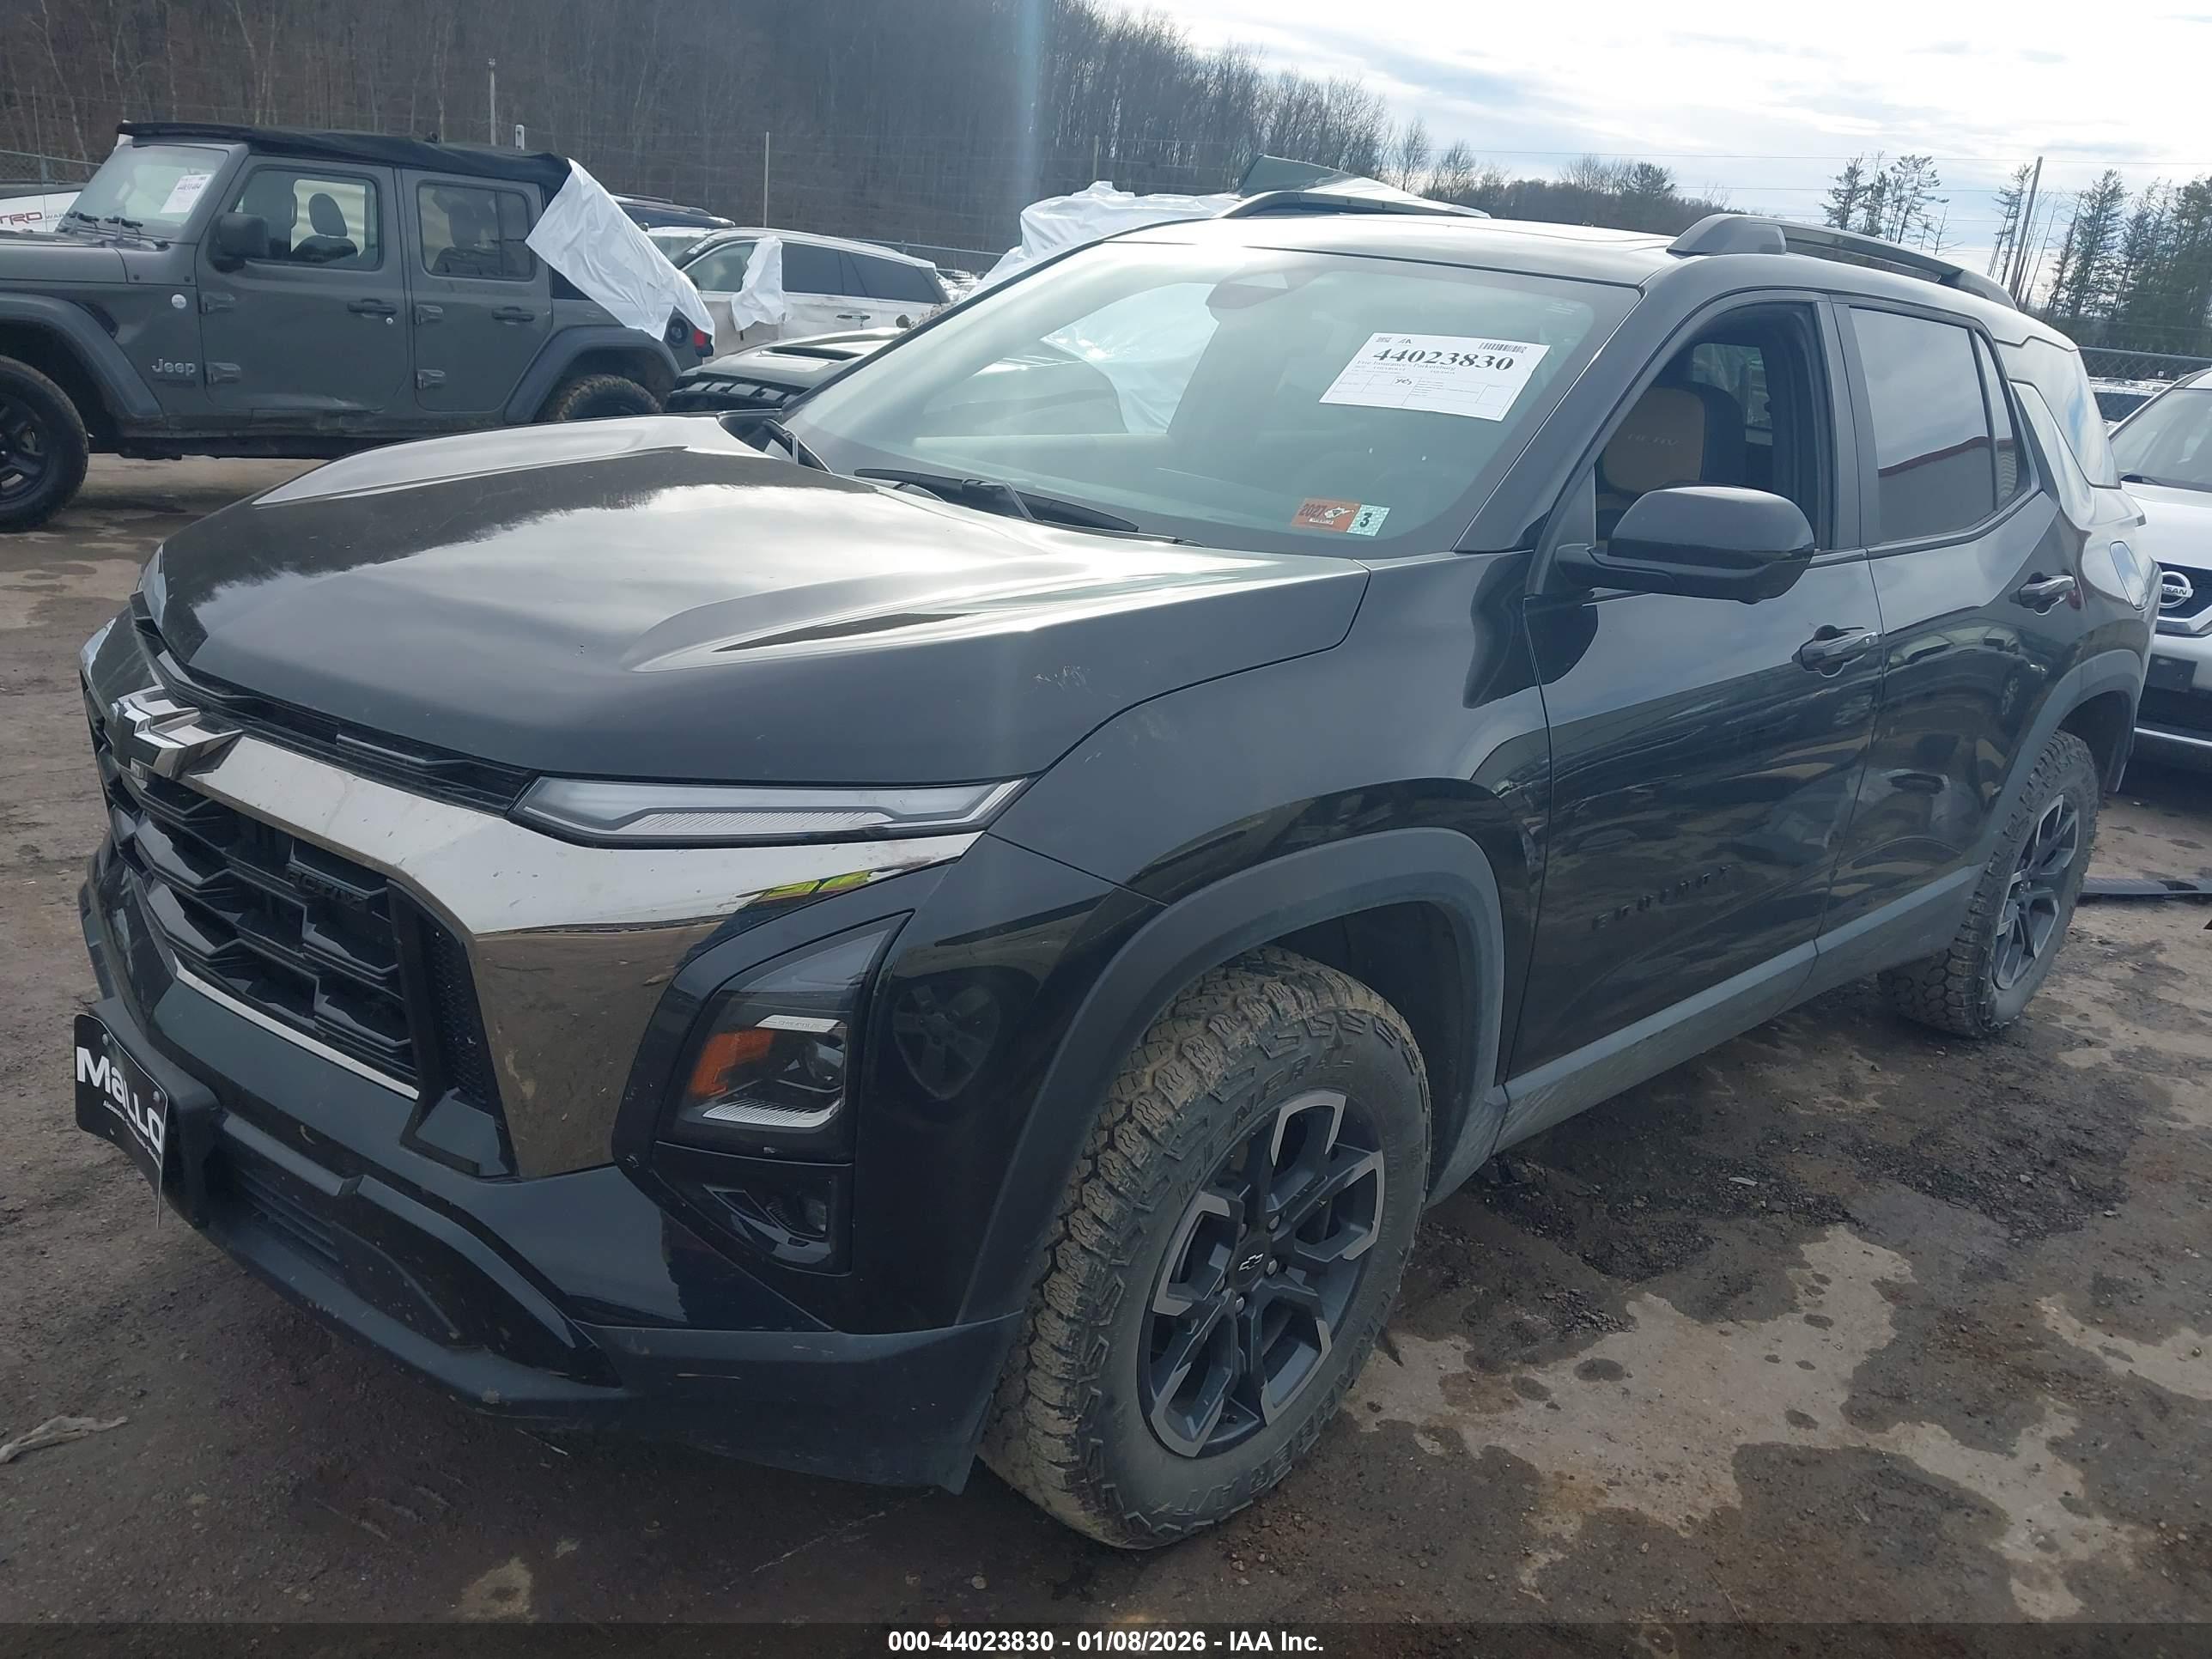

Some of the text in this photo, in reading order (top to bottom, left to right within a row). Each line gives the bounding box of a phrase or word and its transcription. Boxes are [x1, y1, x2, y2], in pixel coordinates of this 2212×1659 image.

[0, 211, 43, 225] TRD
[151, 358, 196, 377] Jeep
[1373, 349, 1515, 371] 44023830
[1360, 513, 1372, 527] 3
